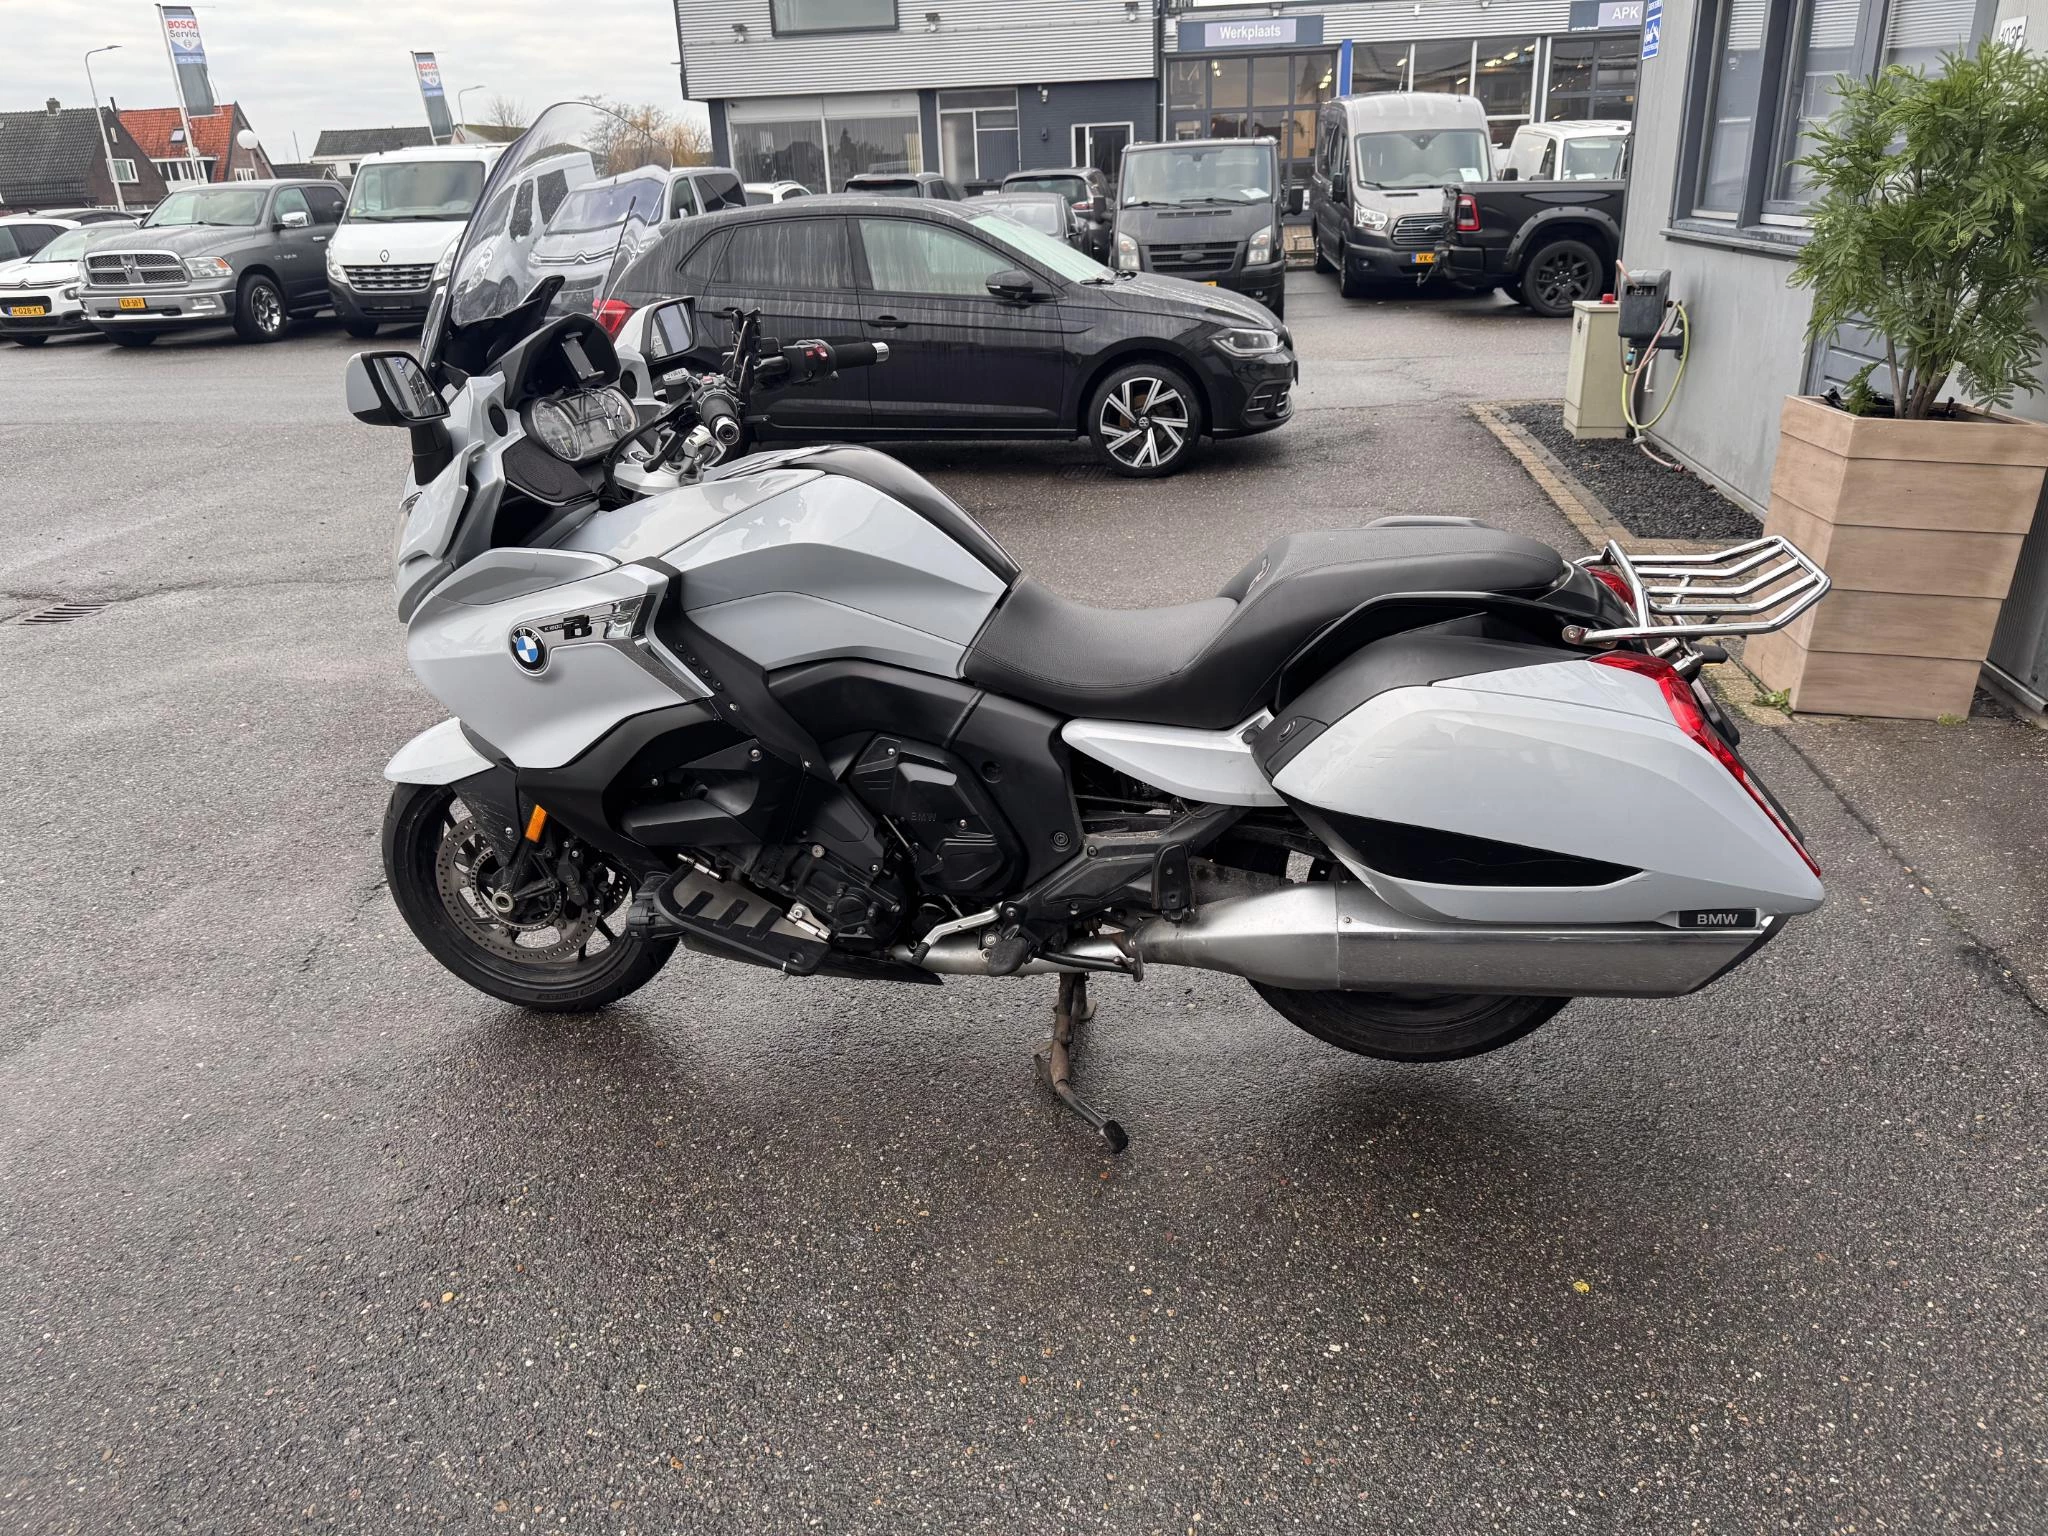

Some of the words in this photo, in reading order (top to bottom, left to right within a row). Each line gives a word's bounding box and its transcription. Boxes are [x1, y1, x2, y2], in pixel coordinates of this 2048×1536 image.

[1612, 6, 1639, 20] APK
[167, 20, 197, 29] BOSCH
[1220, 24, 1281, 41] Werkplaats
[512, 628, 539, 642] BMW
[1697, 913, 1738, 925] BMW
